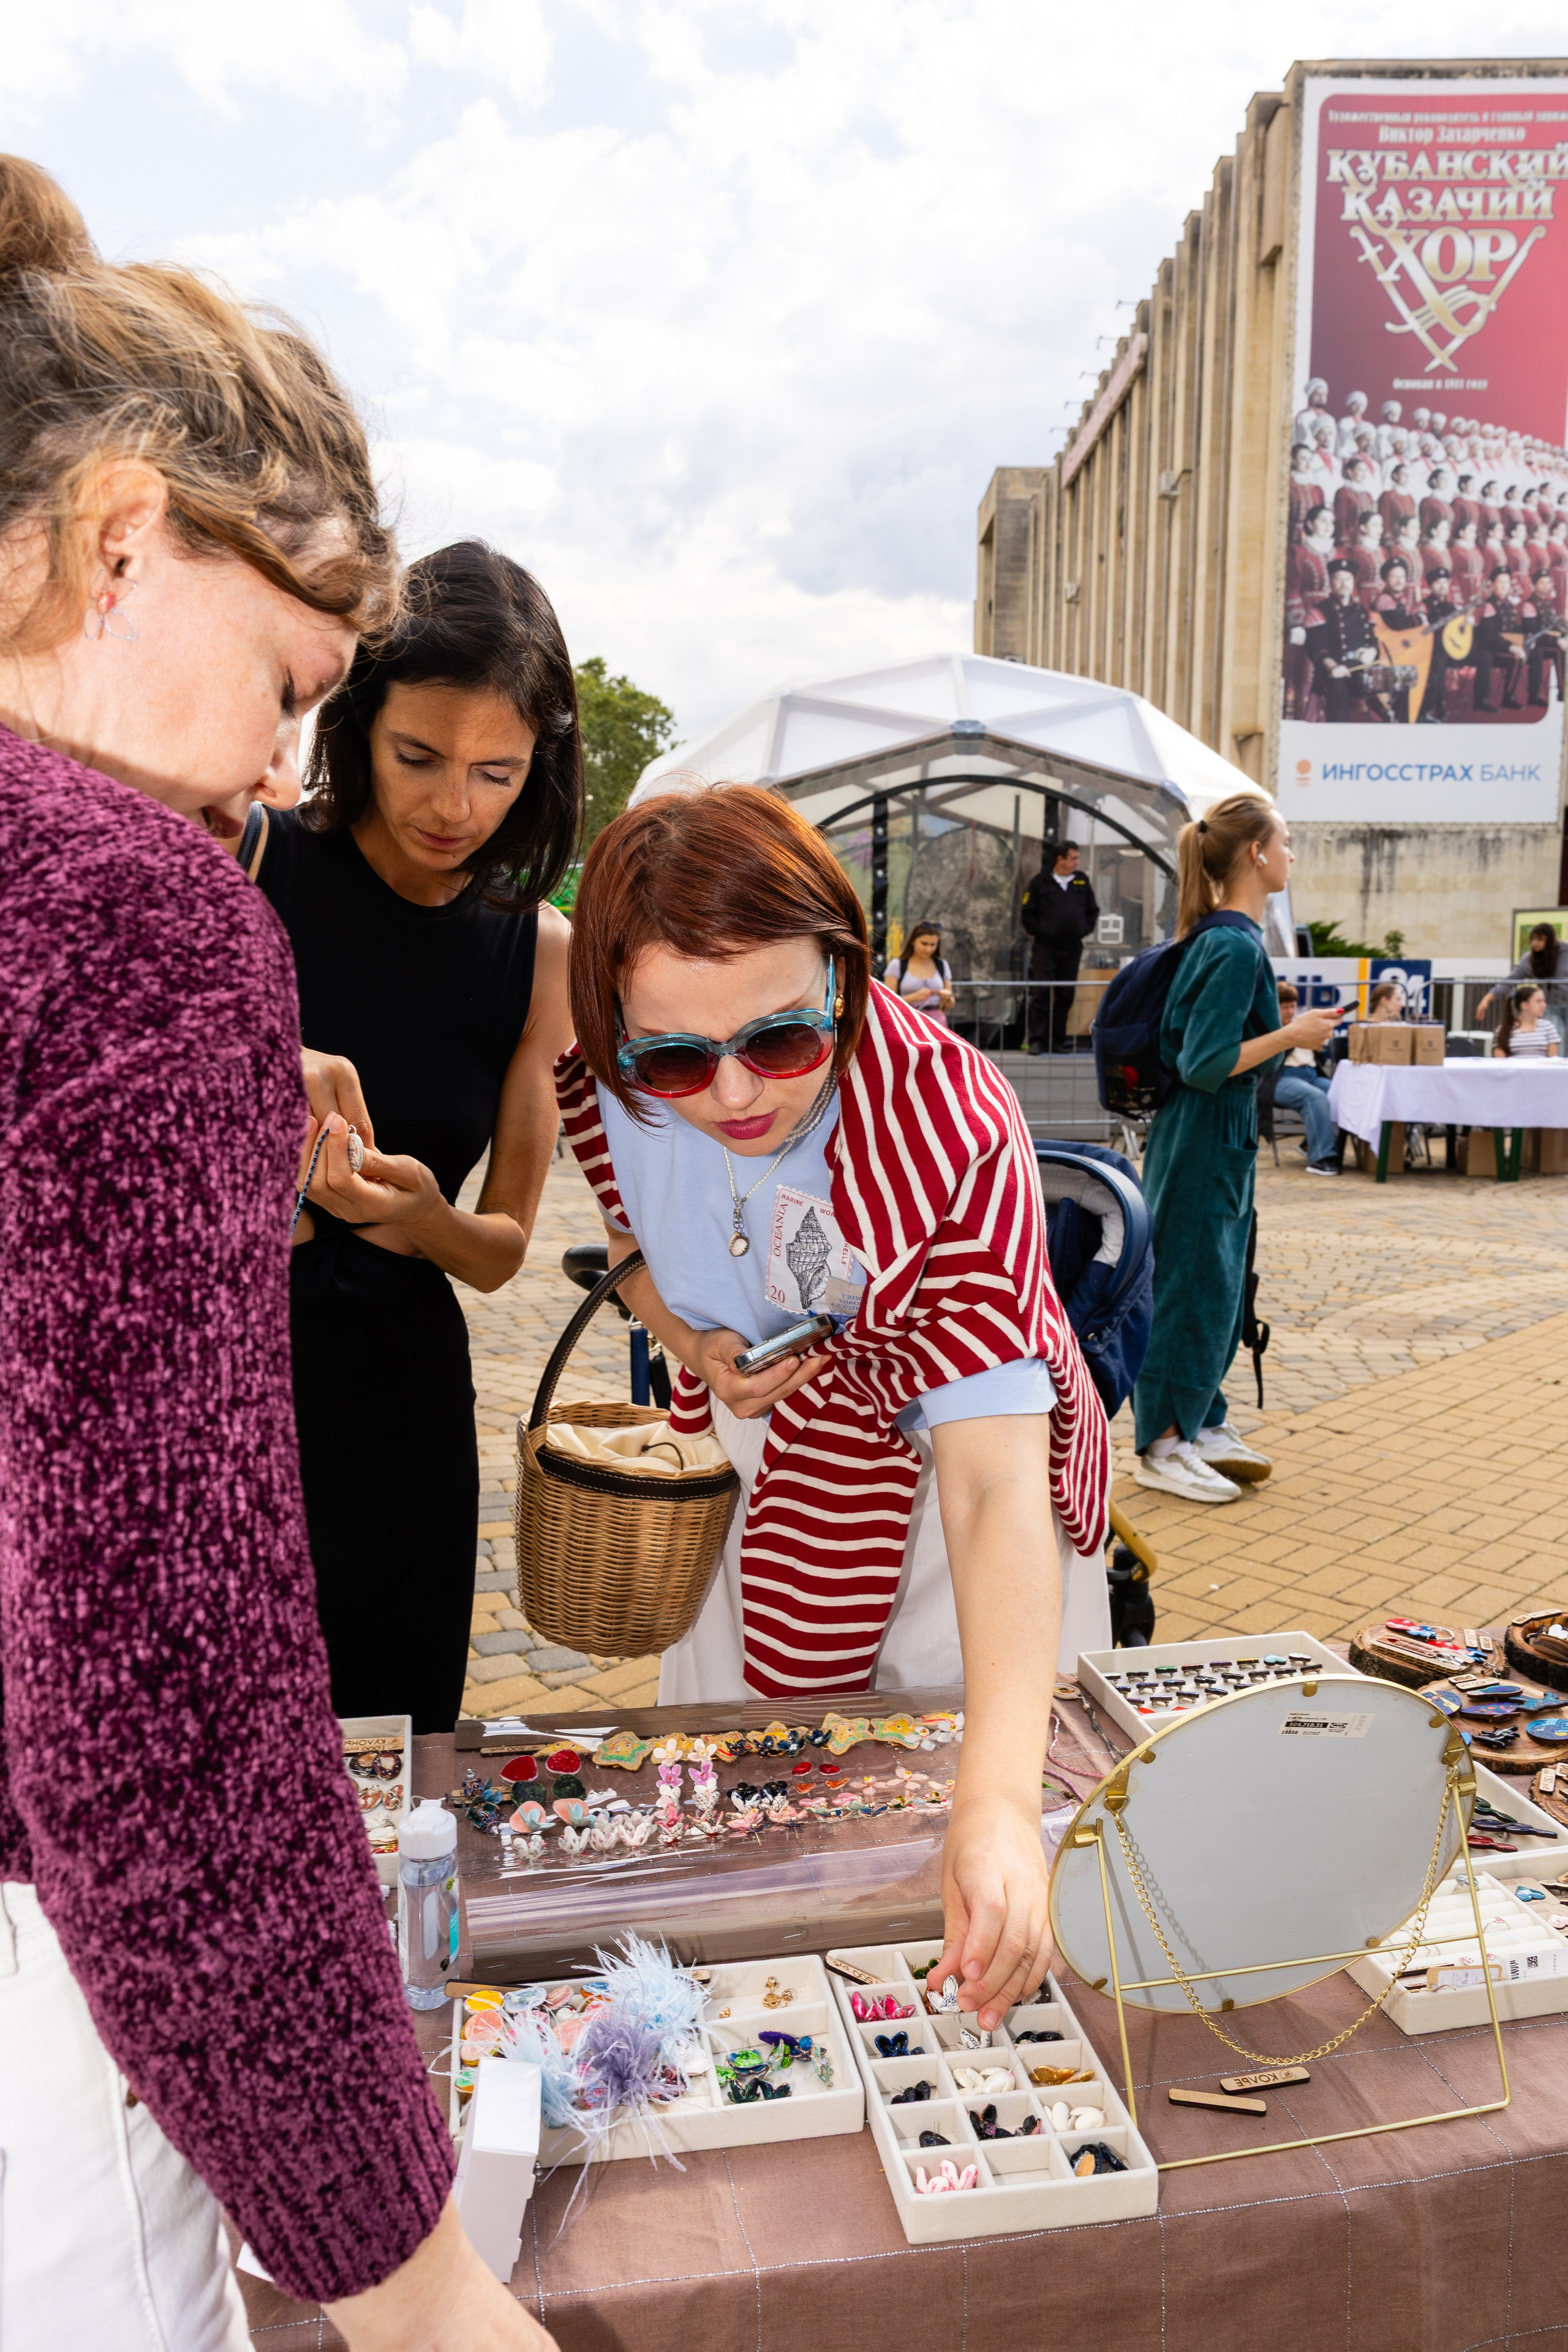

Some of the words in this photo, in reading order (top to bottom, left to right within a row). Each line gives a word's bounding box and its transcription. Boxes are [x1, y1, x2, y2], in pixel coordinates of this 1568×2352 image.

[1379, 124, 1434, 145] Виктор
[1326, 143, 1568, 187] КУБАНСКИЙ
[1340, 181, 1556, 235] КАЗАЧИЙ
[1322, 763, 1474, 782] ИНГОССТРАХ
[1480, 764, 1542, 782] БАНК
[780, 1193, 804, 1207] MARINE
[773, 1203, 788, 1257] OCEANIA
[769, 1285, 786, 1303] 20
[1354, 1715, 1367, 1731] 2002
[1543, 1775, 1554, 1784] 150
[1234, 2072, 1279, 2087] КОЛЬЕ
